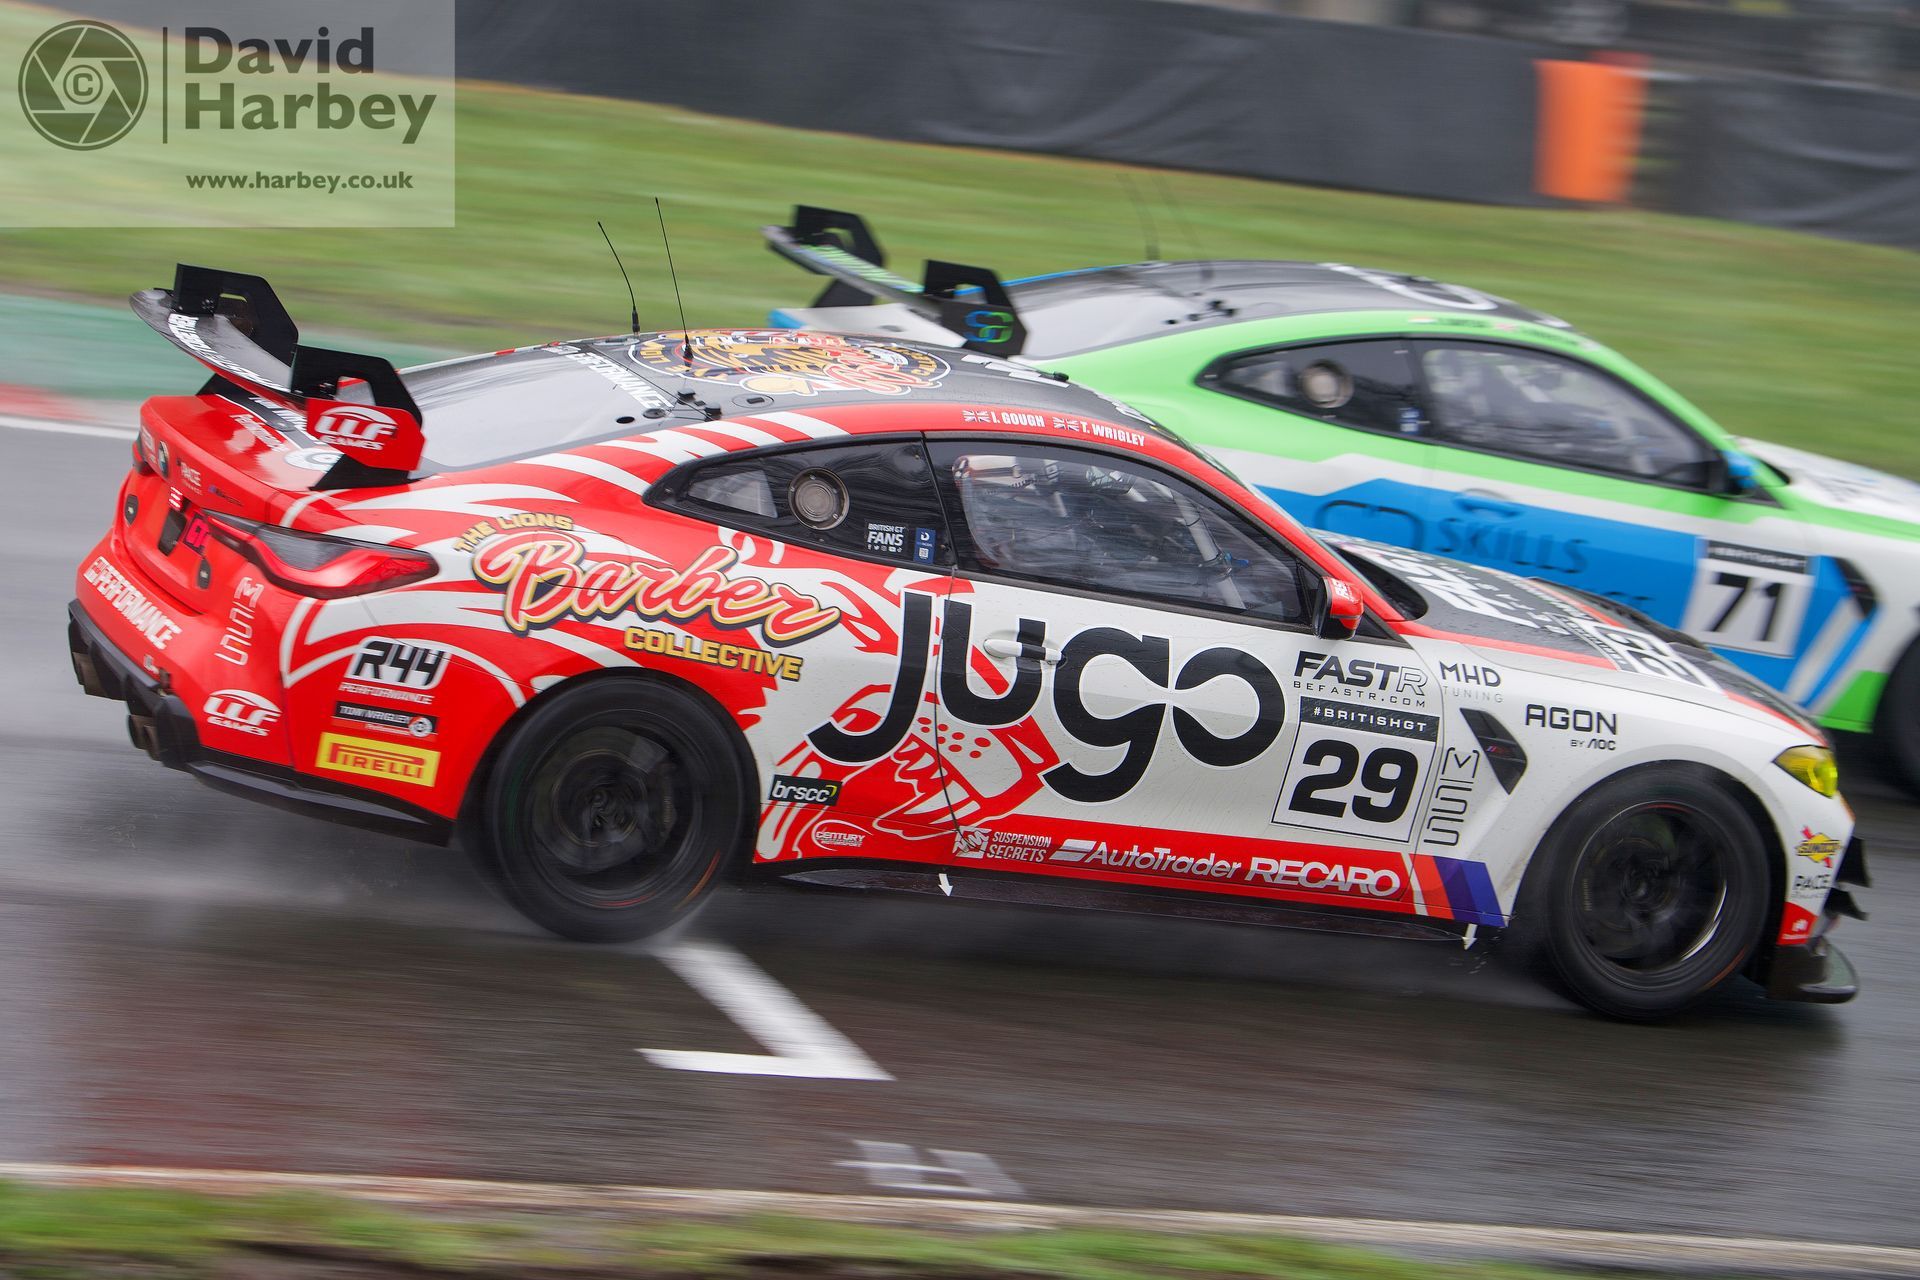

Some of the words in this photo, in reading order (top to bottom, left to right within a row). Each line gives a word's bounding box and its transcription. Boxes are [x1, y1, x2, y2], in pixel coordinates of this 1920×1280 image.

[1001, 412, 1046, 428] GOUGH
[1080, 421, 1091, 434] T.
[1091, 424, 1146, 447] WRIGLEY
[319, 435, 386, 451] GAMES
[454, 519, 497, 553] THE
[496, 511, 575, 532] LIONS
[866, 531, 904, 547] FANS
[867, 523, 894, 533] BRITISH
[1435, 516, 1588, 575] SKILLS
[472, 531, 841, 648] Barber
[1711, 571, 1786, 642] 71
[353, 640, 447, 687] R44
[623, 626, 804, 682] COLLECTIVE
[1293, 650, 1428, 696] FASTR
[1438, 660, 1502, 688] MHD
[338, 681, 436, 705] PERFORMANCE
[1293, 680, 1426, 708] BEFASTR.COM
[1442, 685, 1504, 704] TUNING
[1312, 705, 1427, 732] #BRITISHGT
[1525, 703, 1618, 736] AGON
[1570, 738, 1584, 748] BY
[328, 743, 426, 779] PIRELLI
[771, 781, 830, 804] brscc
[1289, 739, 1419, 824] 29
[815, 831, 866, 843] CENTURY
[992, 831, 1052, 849] SUSPENSION
[986, 844, 1047, 863] SECRETS
[1085, 840, 1242, 881] AutoTrader
[1244, 857, 1400, 897] RECARO
